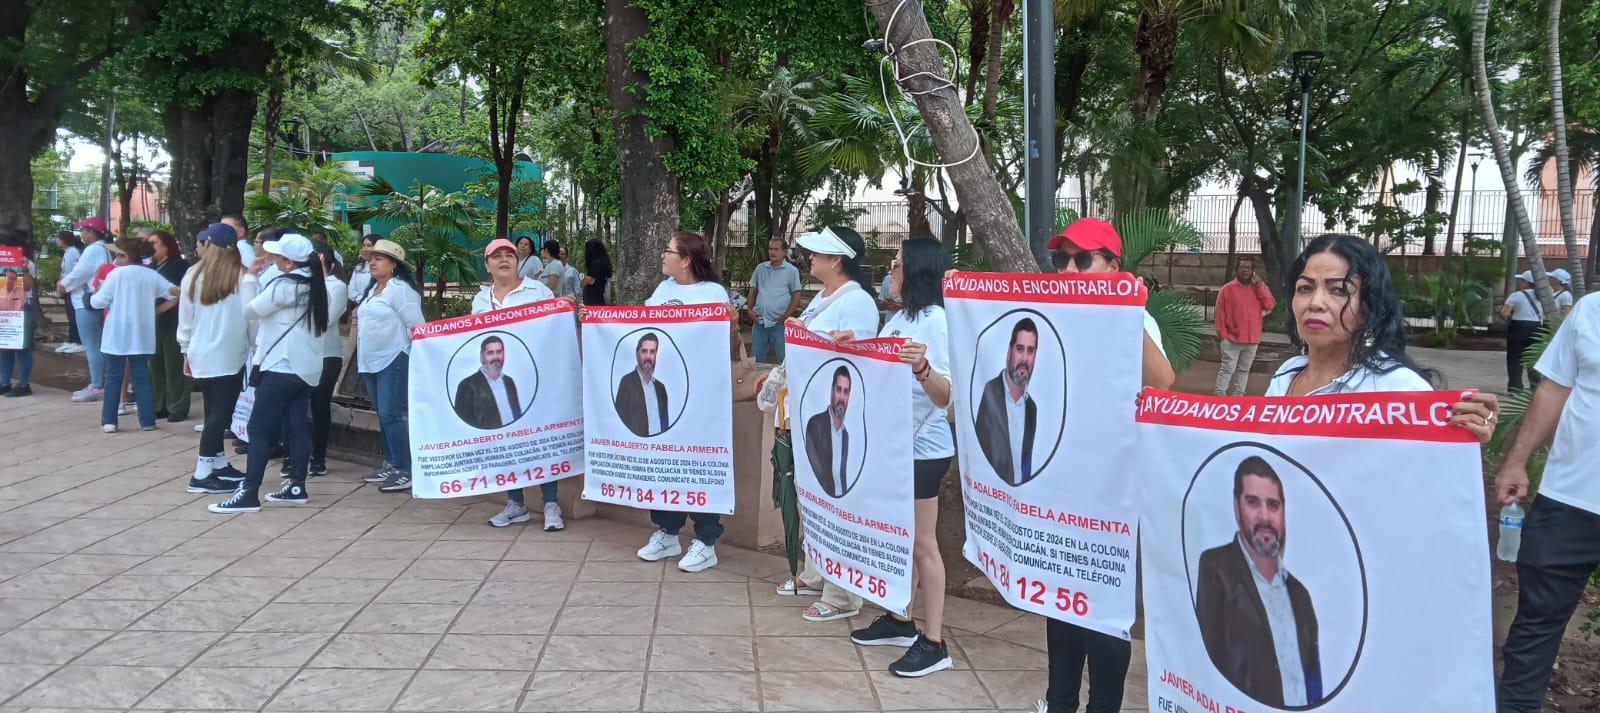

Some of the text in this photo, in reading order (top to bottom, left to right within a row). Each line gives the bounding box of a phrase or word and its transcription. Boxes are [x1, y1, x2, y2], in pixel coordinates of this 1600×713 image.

[944, 275, 1140, 296] ¡AYÚDANOS A ENCONTRARLO!
[474, 316, 482, 326] A
[640, 310, 646, 318] A
[650, 306, 726, 318] ENCONTRARLO!
[1140, 394, 1242, 422] ¡AYÚDANOS
[1242, 404, 1254, 421] A
[418, 442, 450, 450] JAVIER
[452, 434, 504, 447] ADALBERTO
[506, 426, 542, 438] FABELA
[612, 440, 648, 450] ADALBERTO
[651, 444, 685, 452] FABELA
[686, 446, 728, 454] ARMENTA
[440, 460, 571, 494] 66 71 84 12 56
[602, 482, 706, 506] 66 71 84 12 56
[836, 507, 864, 526] FABELA
[864, 518, 910, 538] ARMENTA
[1058, 512, 1130, 536] ARMENTA
[1034, 530, 1045, 542] DE
[1046, 533, 1063, 545] 2024
[1065, 538, 1076, 549] EN
[1078, 540, 1090, 552] LA
[1091, 544, 1130, 560] COLONIA
[1014, 553, 1062, 574] COMUNÍCATE
[1063, 566, 1074, 578] AL
[1076, 568, 1121, 588] TELÉFONO
[1050, 548, 1058, 559] SI
[1059, 550, 1088, 566] TIENES
[1091, 558, 1126, 574] ALGUNA
[826, 558, 842, 579] 84
[848, 566, 864, 588] 12
[868, 576, 886, 598] 56
[1016, 576, 1046, 605] 12
[1056, 587, 1088, 616] 56
[1160, 668, 1194, 700] JAVIER
[1158, 696, 1172, 712] FUE
